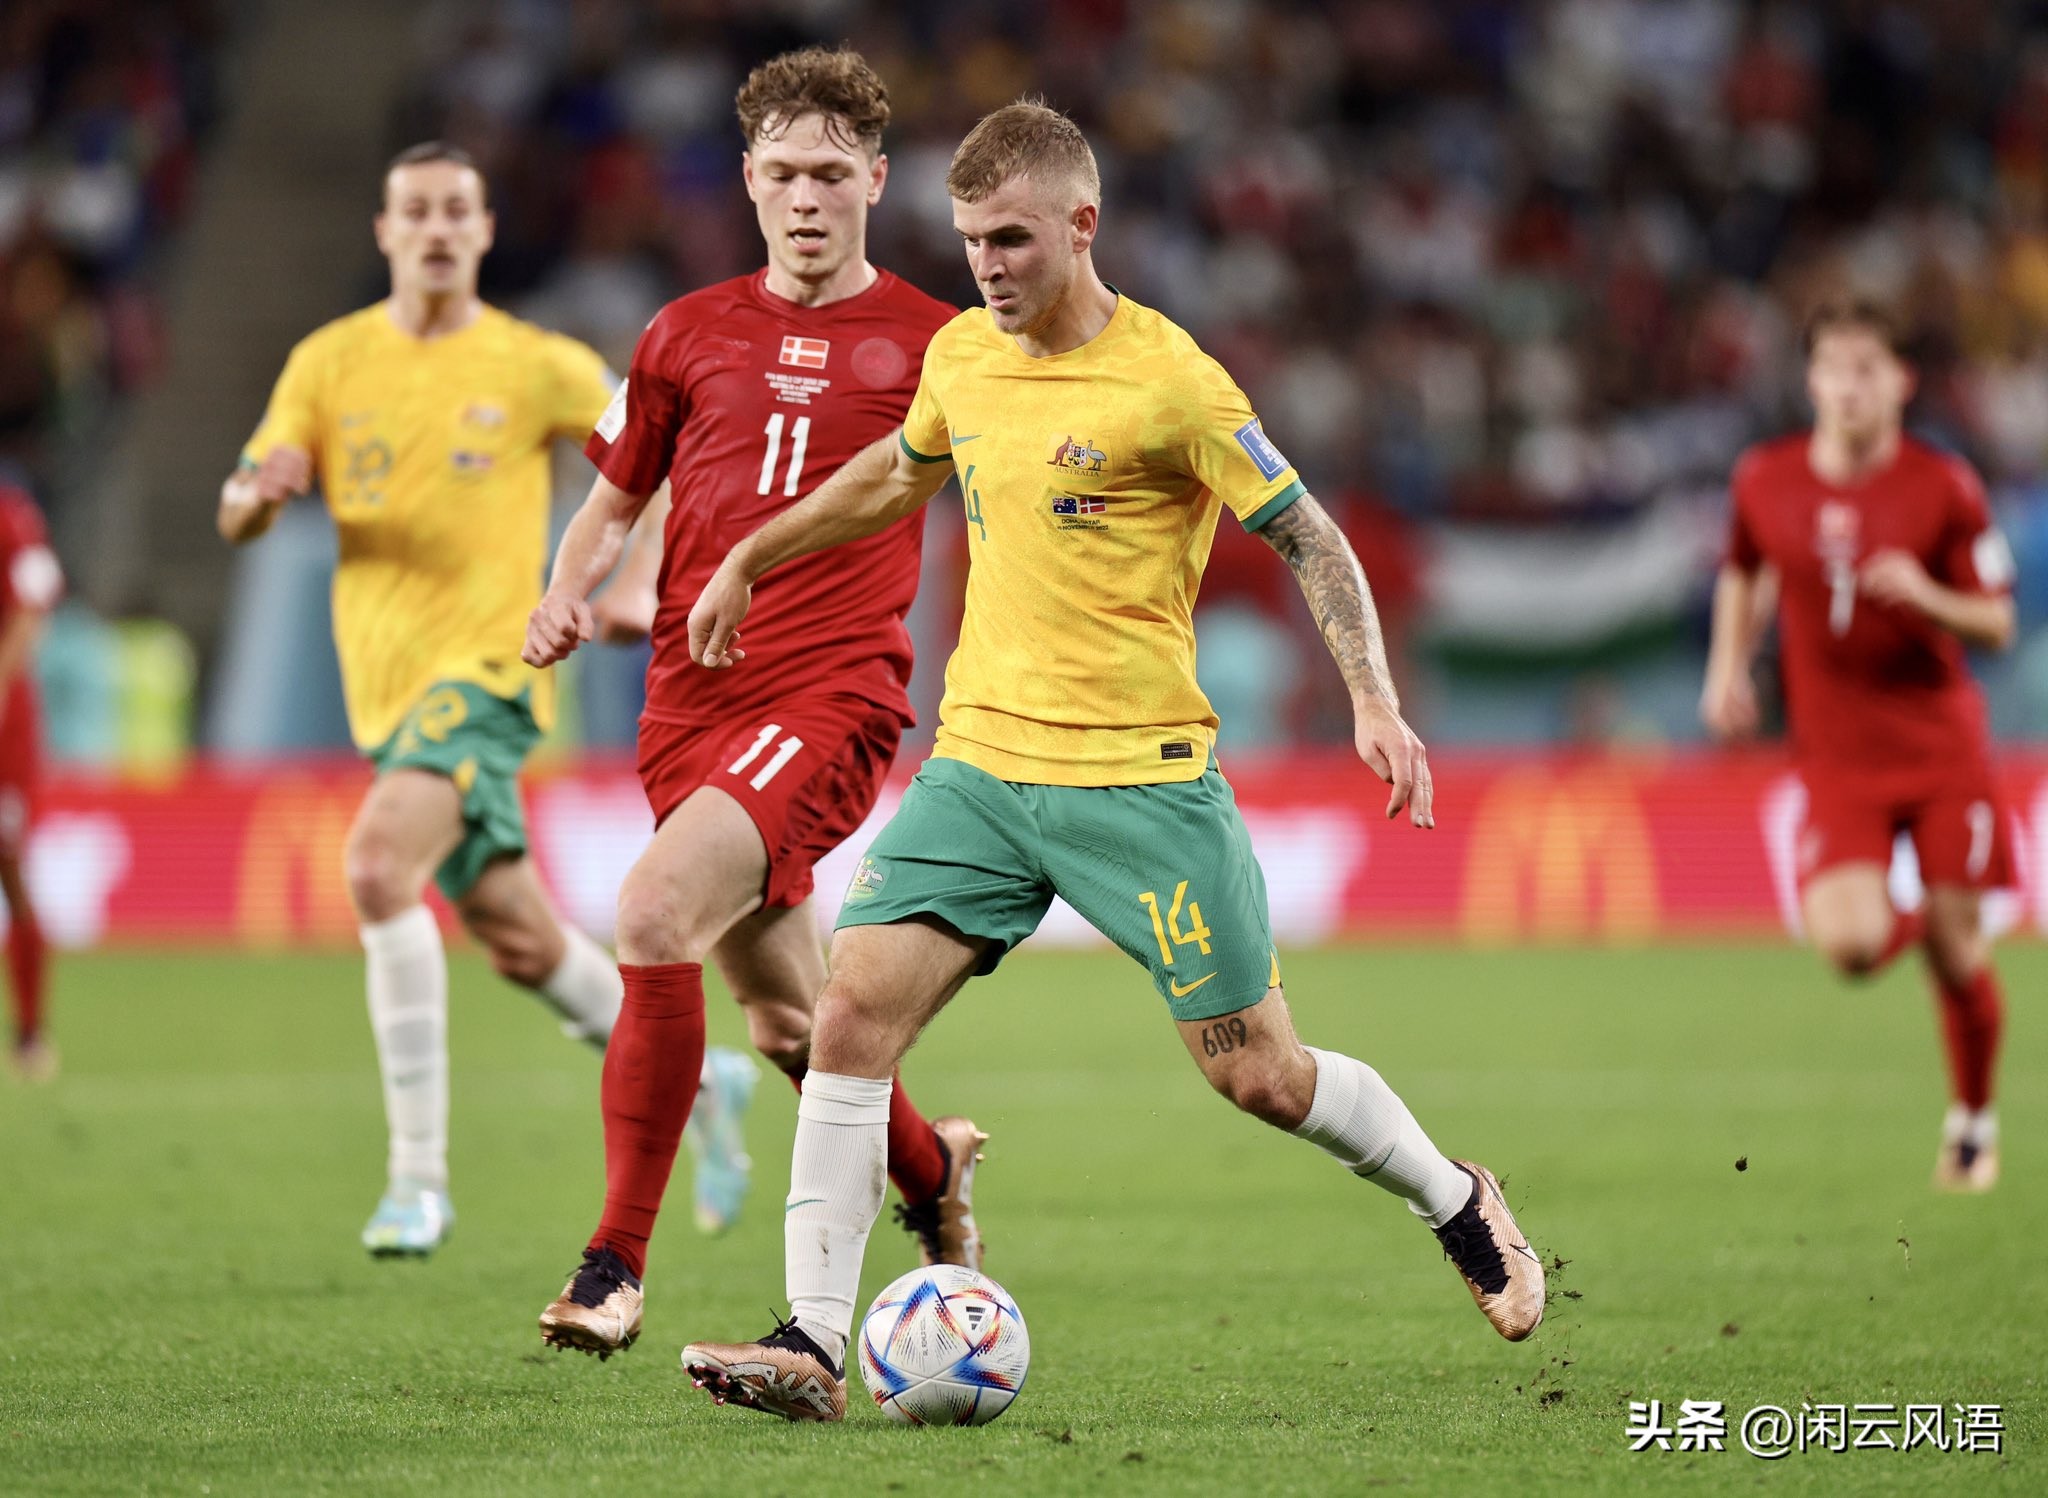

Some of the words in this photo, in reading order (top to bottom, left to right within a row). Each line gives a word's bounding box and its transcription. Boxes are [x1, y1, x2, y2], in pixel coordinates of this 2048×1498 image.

[757, 413, 811, 497] 11
[1055, 466, 1099, 477] AUSTRALIA
[727, 723, 804, 792] 11
[1138, 880, 1212, 966] 14
[1202, 1017, 1246, 1058] 609
